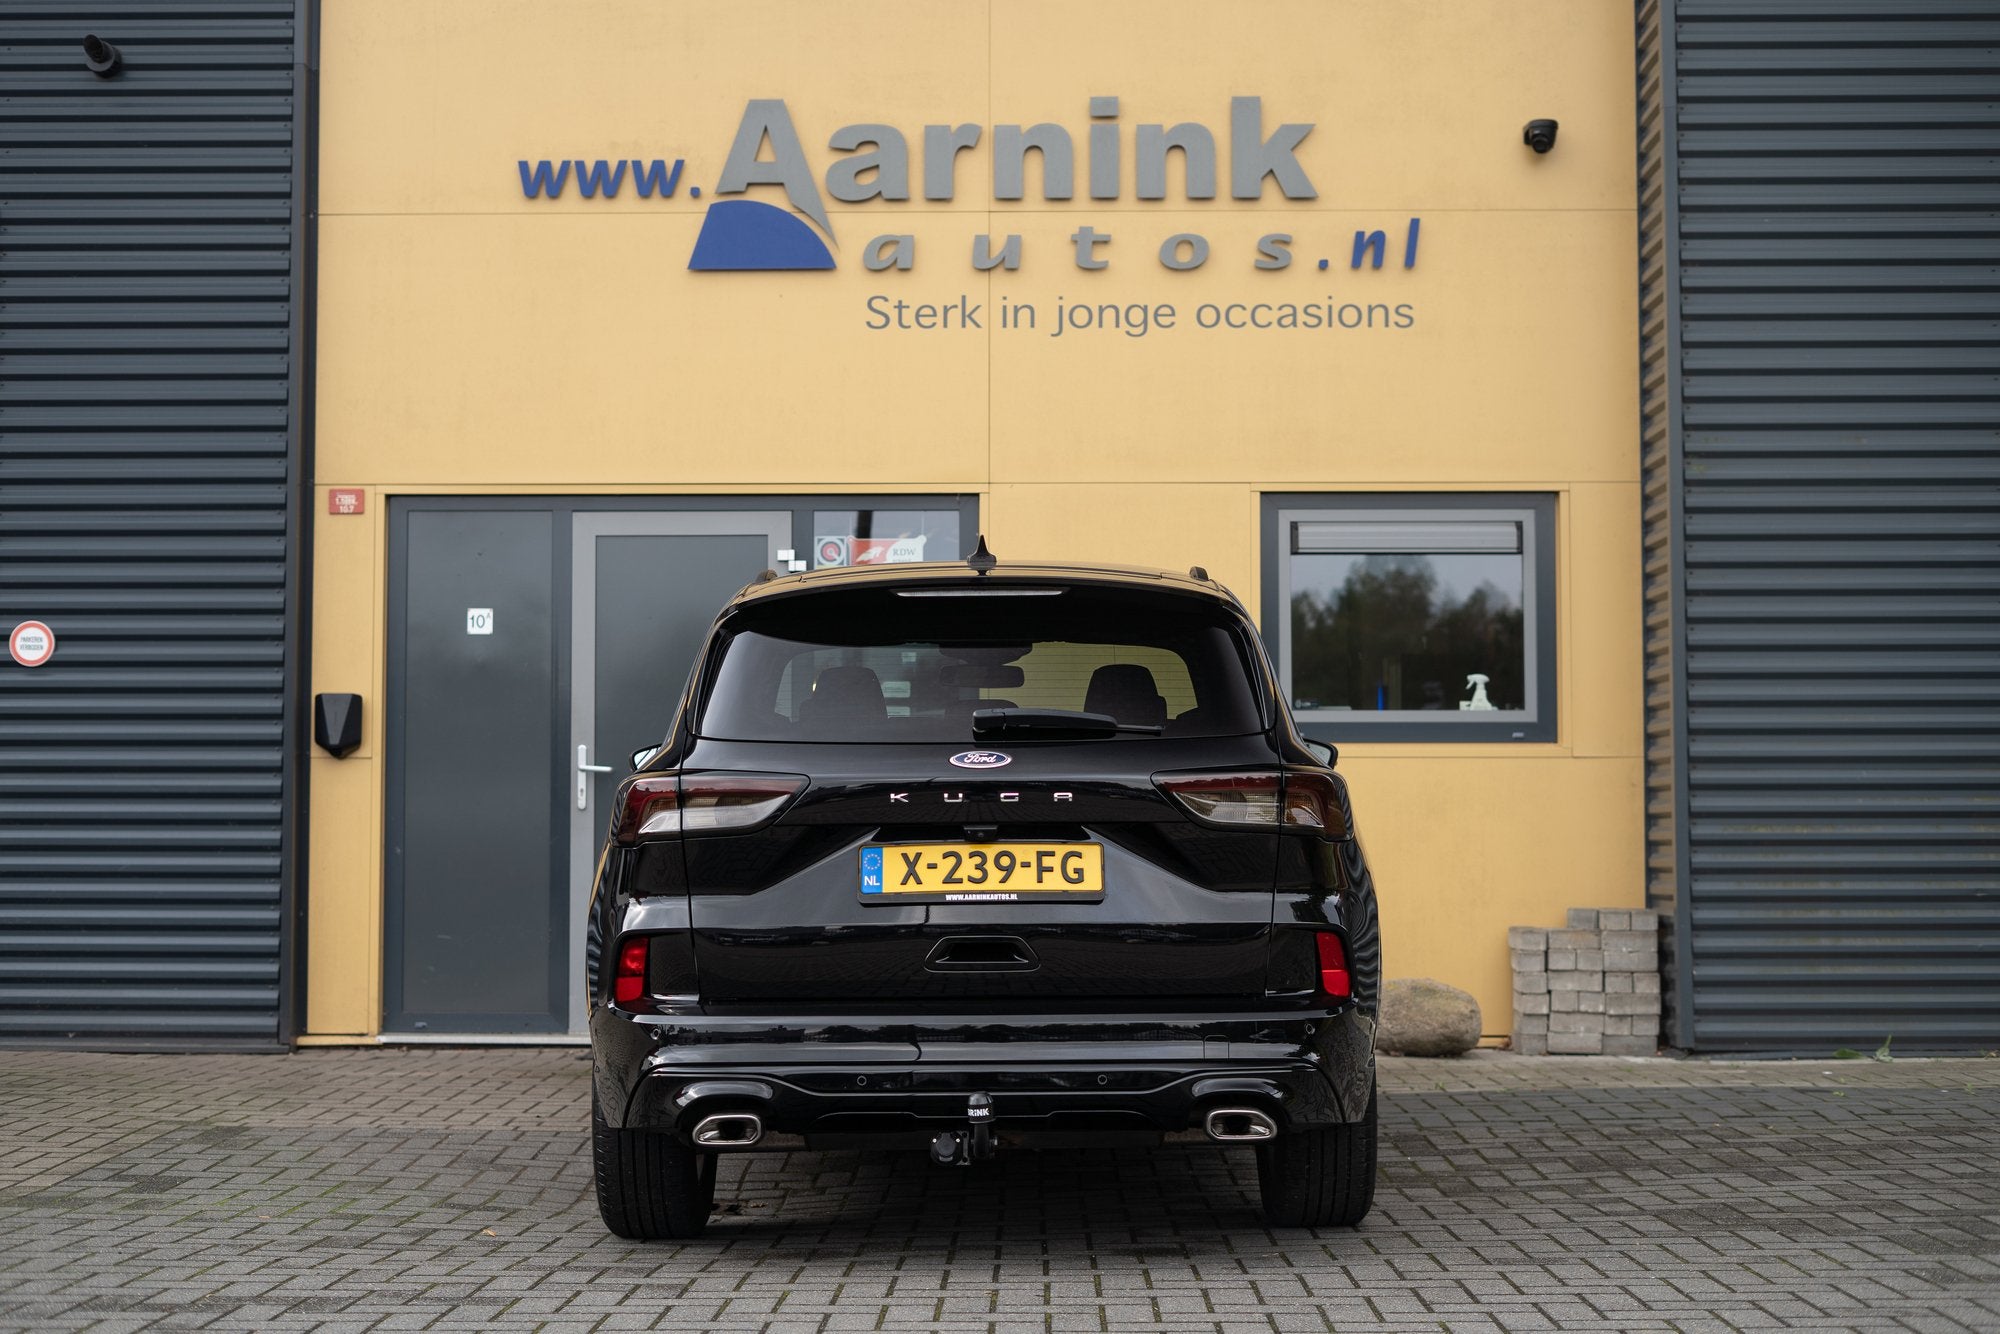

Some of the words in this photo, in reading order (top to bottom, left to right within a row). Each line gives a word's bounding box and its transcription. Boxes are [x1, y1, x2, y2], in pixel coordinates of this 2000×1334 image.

[716, 96, 1319, 250] Aarnink
[865, 295, 983, 329] Sterk
[1001, 297, 1036, 328] in
[1051, 297, 1176, 338] jonge
[1196, 297, 1415, 329] occasions
[964, 753, 997, 763] Ford
[890, 792, 1073, 803] KUGA
[864, 875, 881, 887] NL
[900, 850, 1085, 886] X-239-FG
[945, 893, 1018, 901] WWW.AARNINKAUTOS.NL
